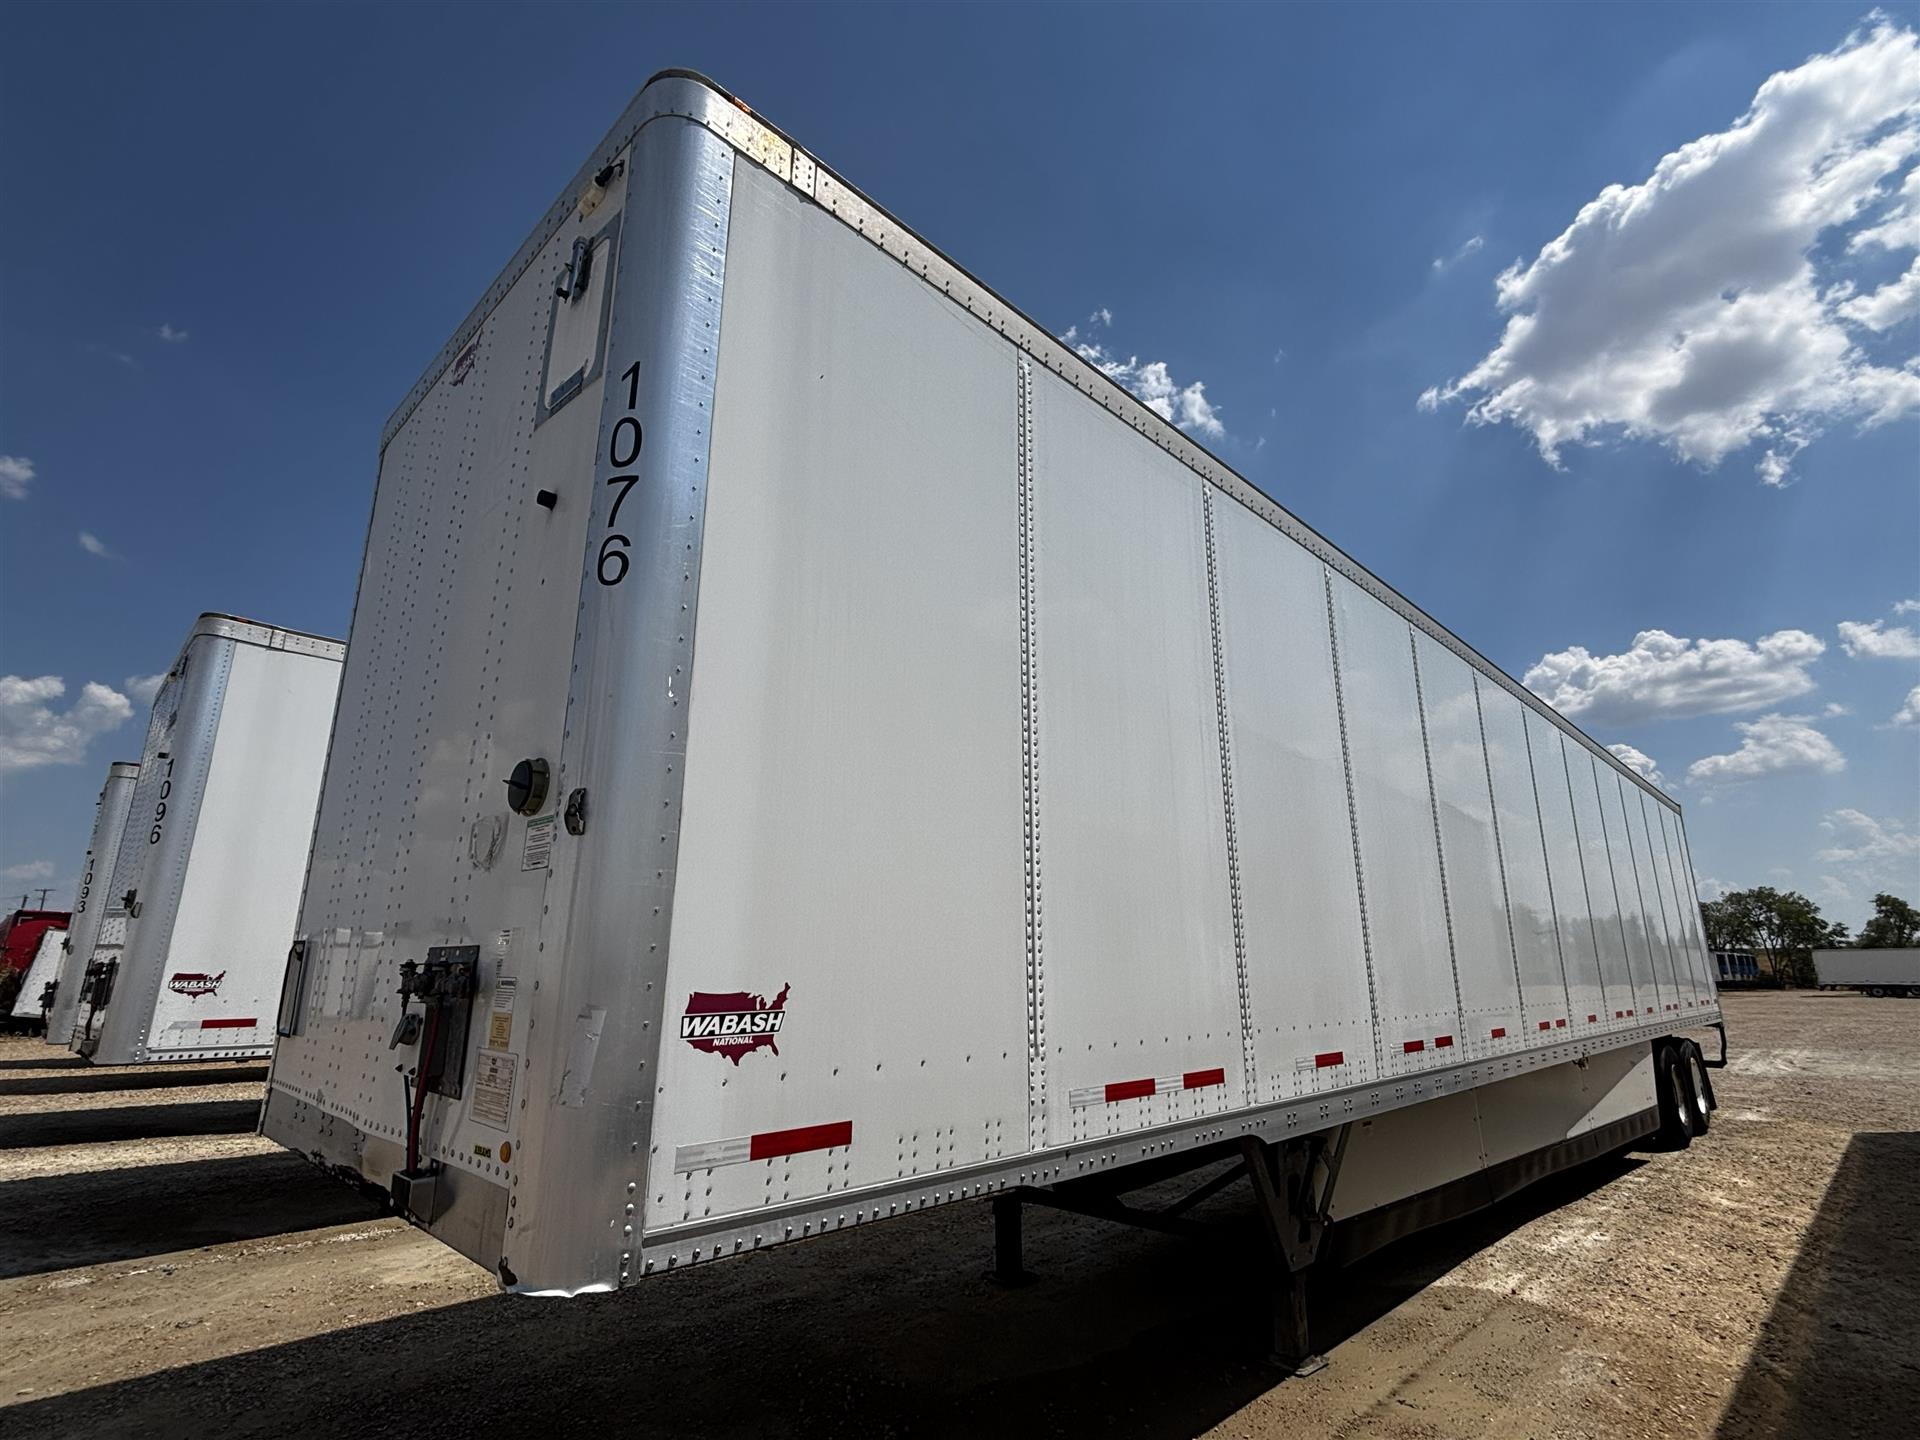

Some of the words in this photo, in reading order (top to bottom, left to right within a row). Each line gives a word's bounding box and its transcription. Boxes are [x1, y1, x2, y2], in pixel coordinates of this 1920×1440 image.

[597, 361, 642, 586] 1076
[150, 758, 174, 844] 1096
[77, 859, 95, 914] 1093
[169, 981, 222, 989] WABASH
[682, 1012, 783, 1037] WABASH
[712, 1036, 753, 1046] NATIONAL
